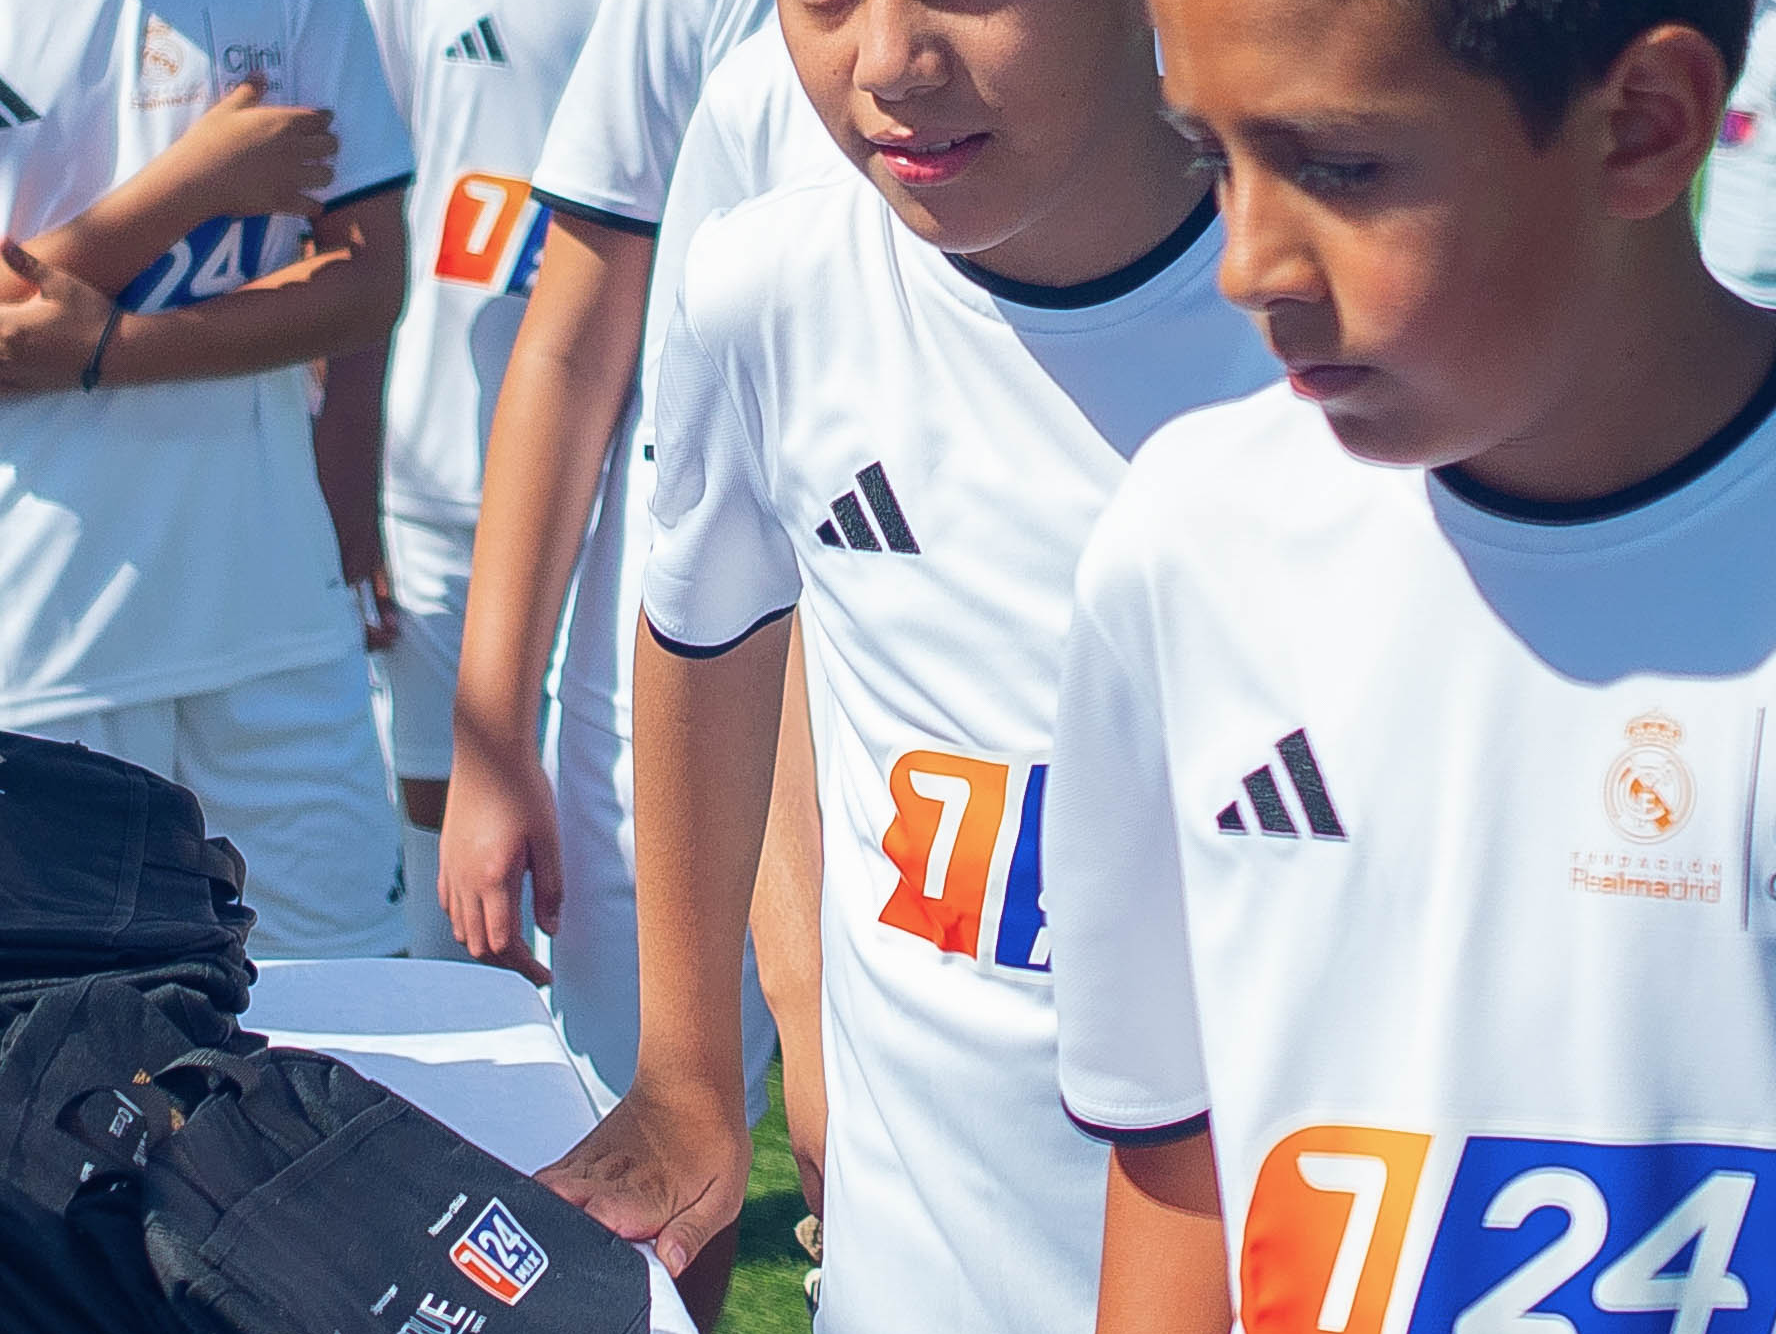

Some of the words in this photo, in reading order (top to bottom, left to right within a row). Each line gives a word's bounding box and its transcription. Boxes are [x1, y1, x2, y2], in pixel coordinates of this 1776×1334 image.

[224, 41, 282, 73] Clini
[463, 179, 508, 256] 7
[908, 768, 972, 901] 7
[477, 1213, 528, 1270] 24
[1296, 1150, 1388, 1334] 7
